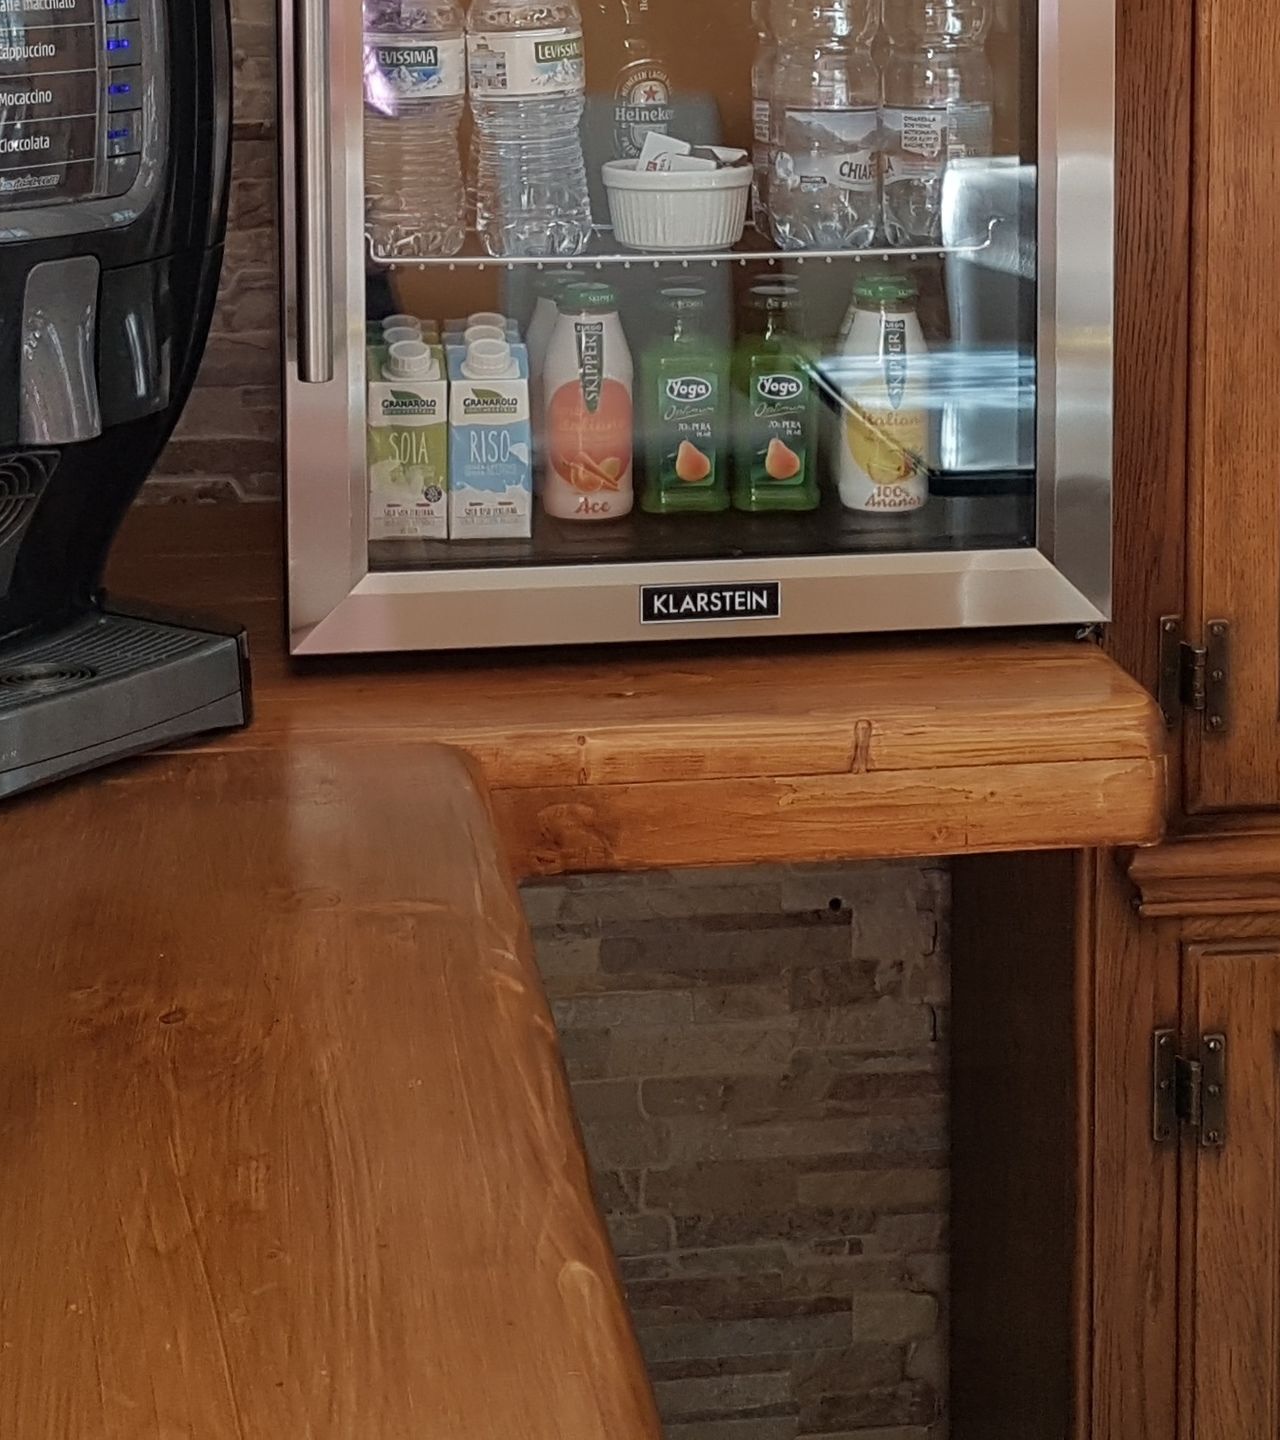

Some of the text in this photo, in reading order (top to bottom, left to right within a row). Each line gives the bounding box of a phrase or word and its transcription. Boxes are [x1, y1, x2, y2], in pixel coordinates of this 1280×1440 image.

[378, 50, 436, 65] EVISSIMA
[0, 136, 50, 153] Cioccolata
[584, 335, 600, 403] SKIPPER
[672, 379, 707, 402] Yoga
[763, 378, 798, 400] Yoga
[382, 399, 436, 408] GRANAROLO
[464, 398, 517, 406] GRANAROLO
[691, 423, 711, 431] PERA
[389, 432, 429, 464] SOIA
[470, 430, 511, 463] RISO
[576, 496, 612, 514] Ace
[653, 590, 769, 614] KLARSTEIN
